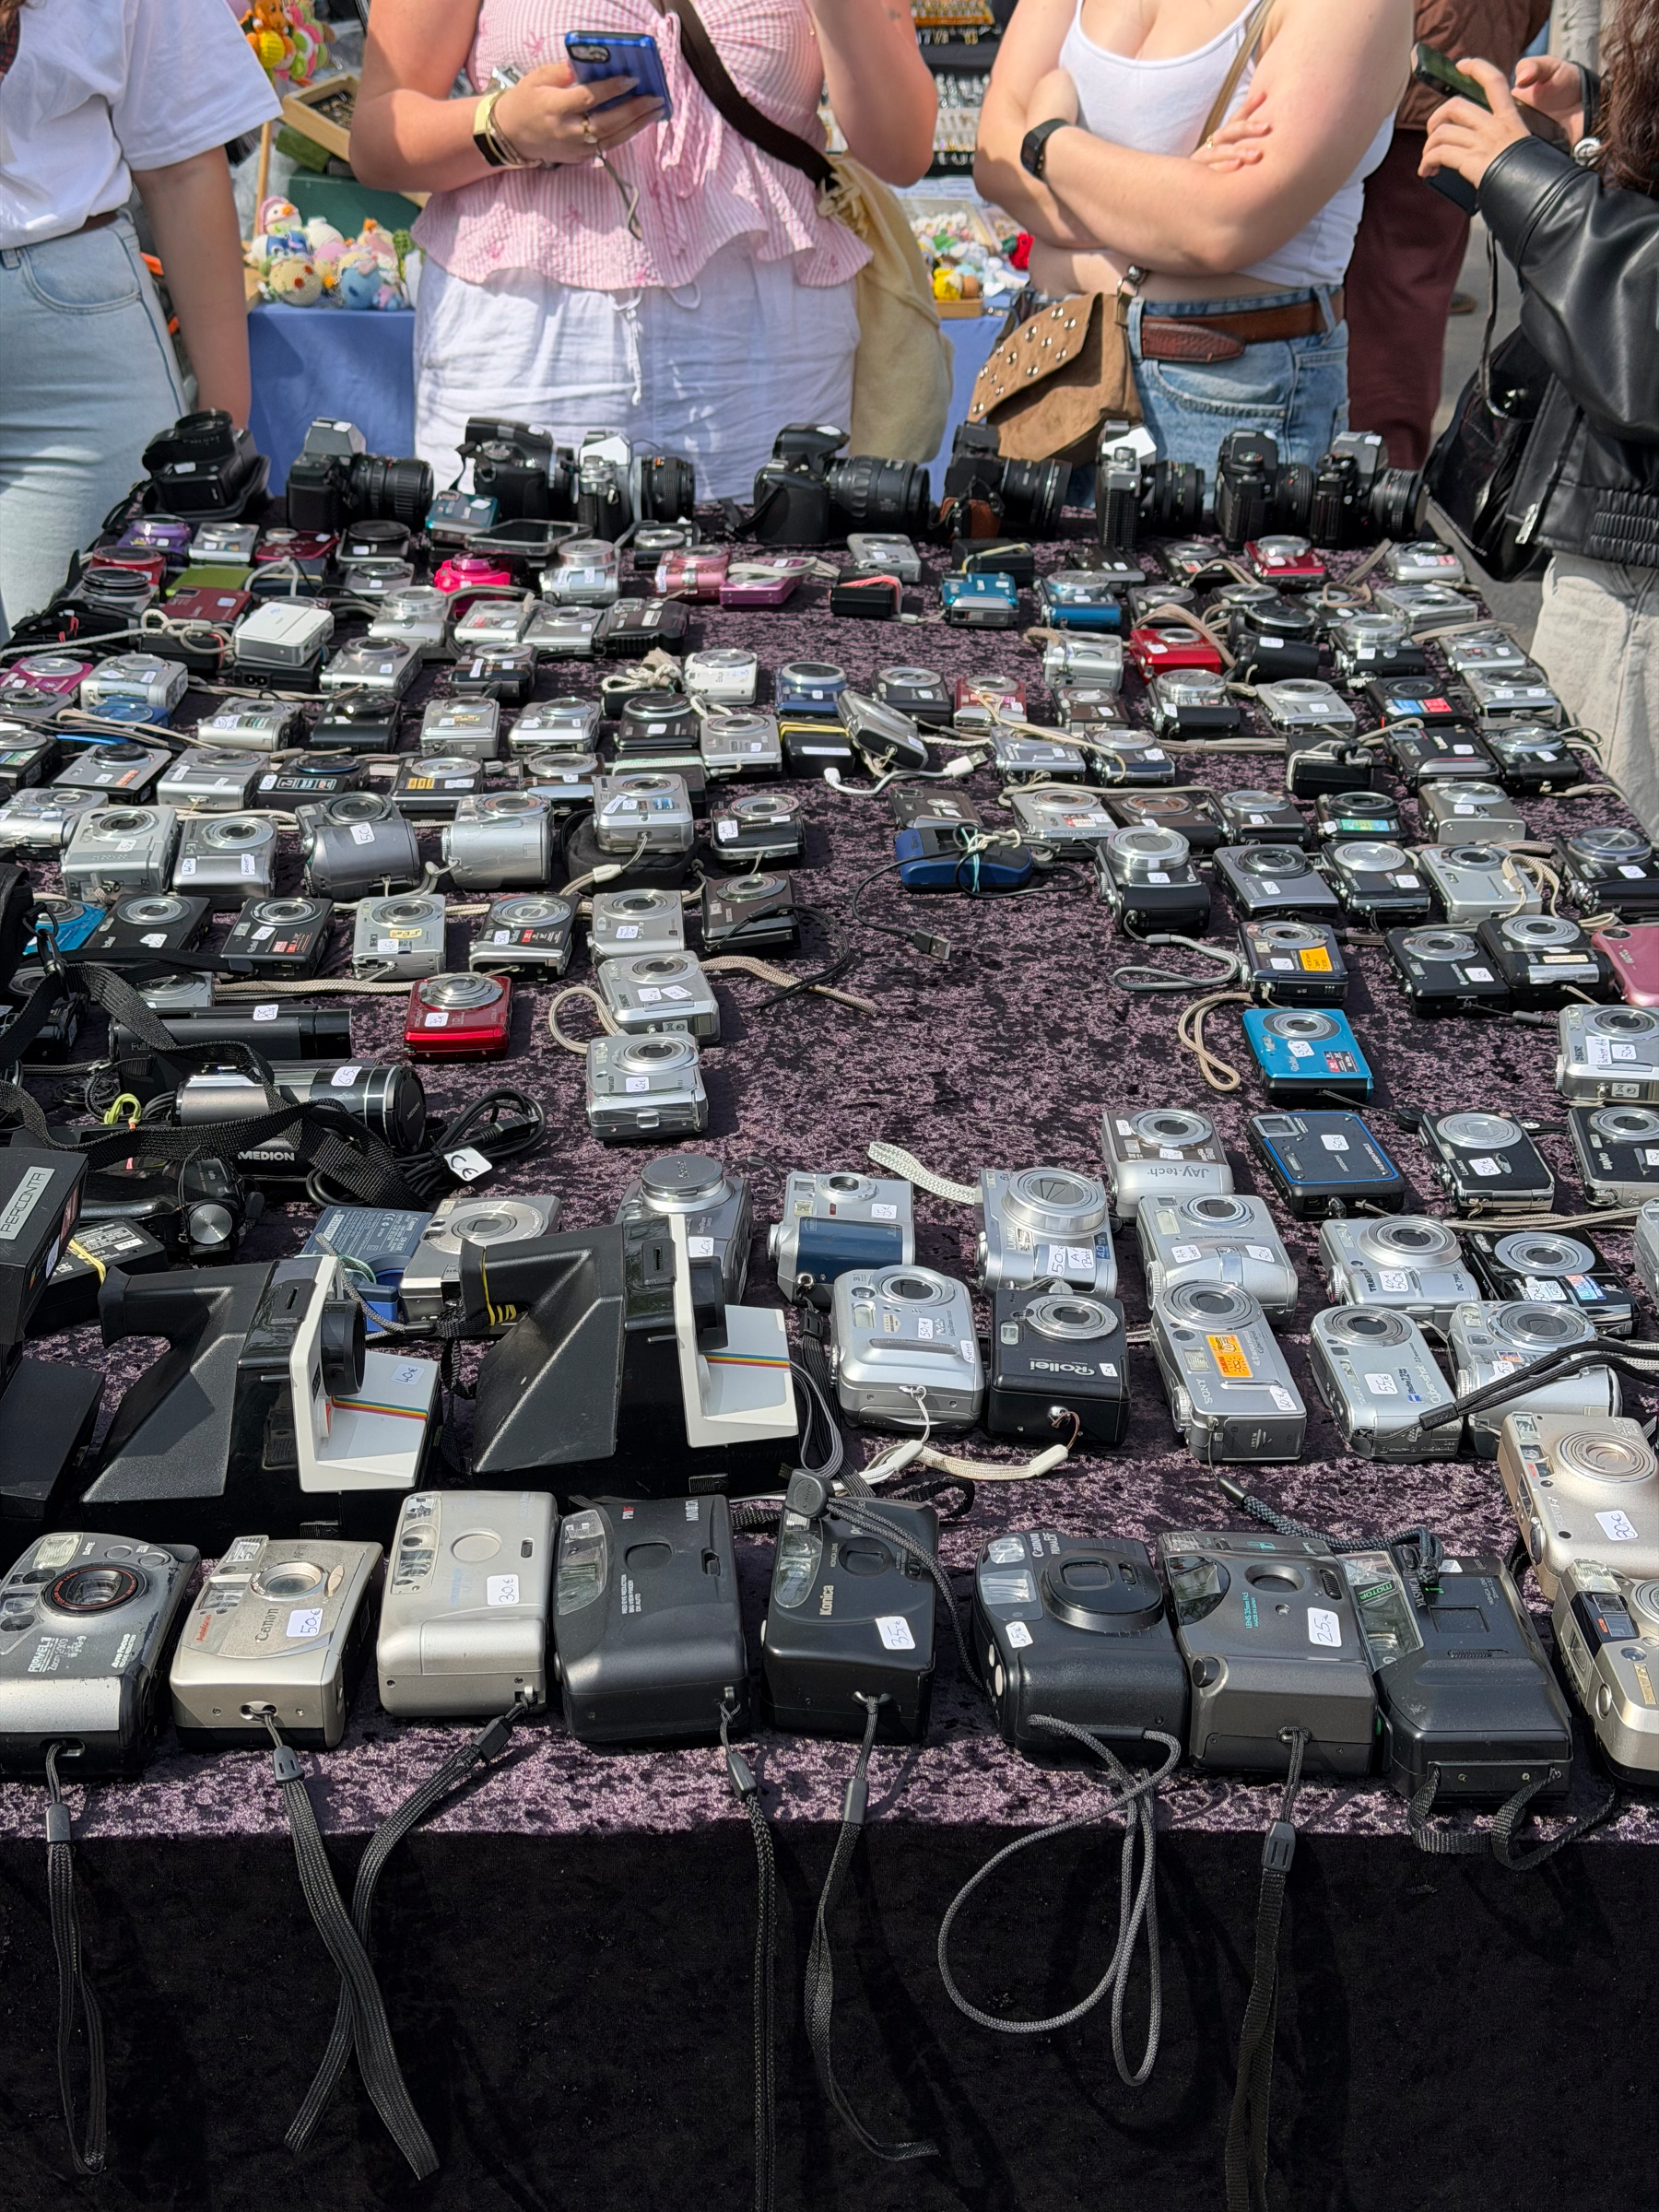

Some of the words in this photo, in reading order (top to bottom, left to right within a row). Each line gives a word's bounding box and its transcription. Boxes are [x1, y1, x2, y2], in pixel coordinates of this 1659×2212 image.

[238, 1150, 295, 1161] MEDION
[2, 1172, 46, 1233] PERCONTA
[1029, 1360, 1096, 1376] Rollei
[1196, 1379, 1214, 1405] SONY
[82, 1542, 96, 1556] DATE
[1031, 1533, 1045, 1558] Canon
[818, 1585, 835, 1616] Konica
[1359, 1583, 1393, 1600] MOTOR
[1408, 1578, 1427, 1608] YASHICA
[254, 1607, 280, 1643] Canon
